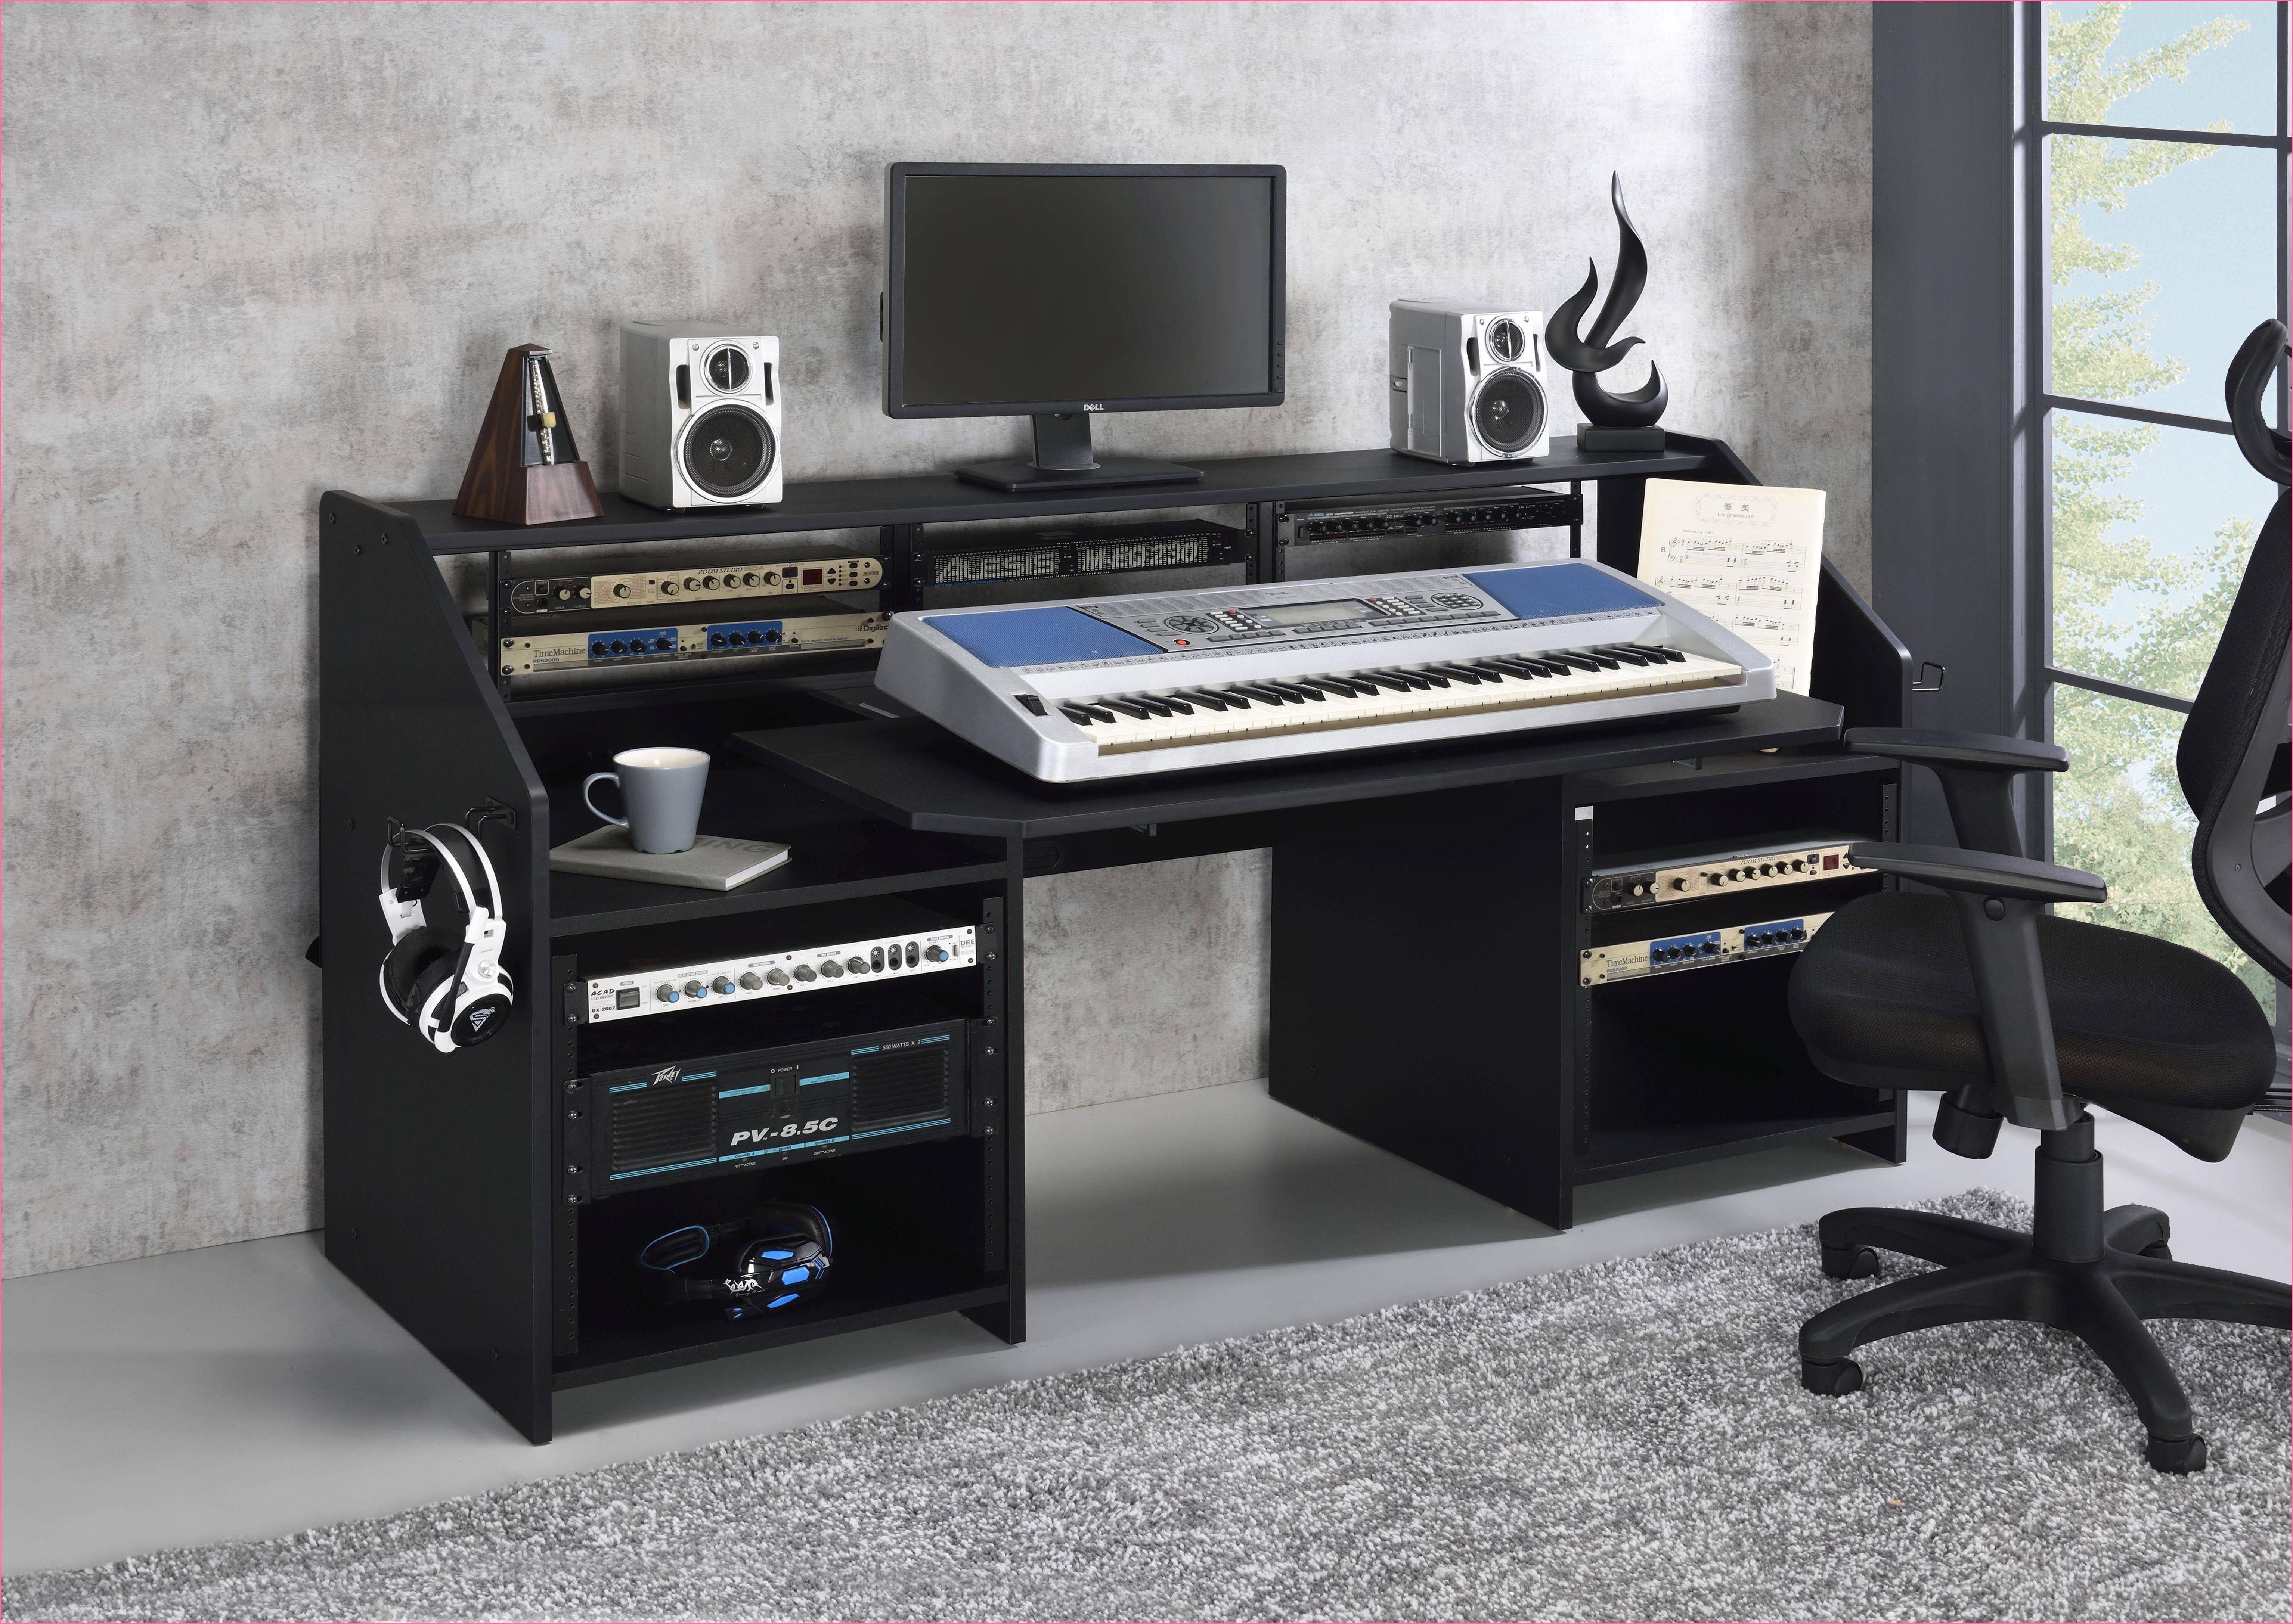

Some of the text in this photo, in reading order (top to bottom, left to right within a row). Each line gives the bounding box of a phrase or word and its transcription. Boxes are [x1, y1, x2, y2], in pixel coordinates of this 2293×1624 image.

[863, 624, 889, 632] DigiTec
[533, 647, 586, 658] TimeMachine
[1606, 955, 1648, 968] TimeMachine
[730, 1117, 839, 1146] PV-8.5C
